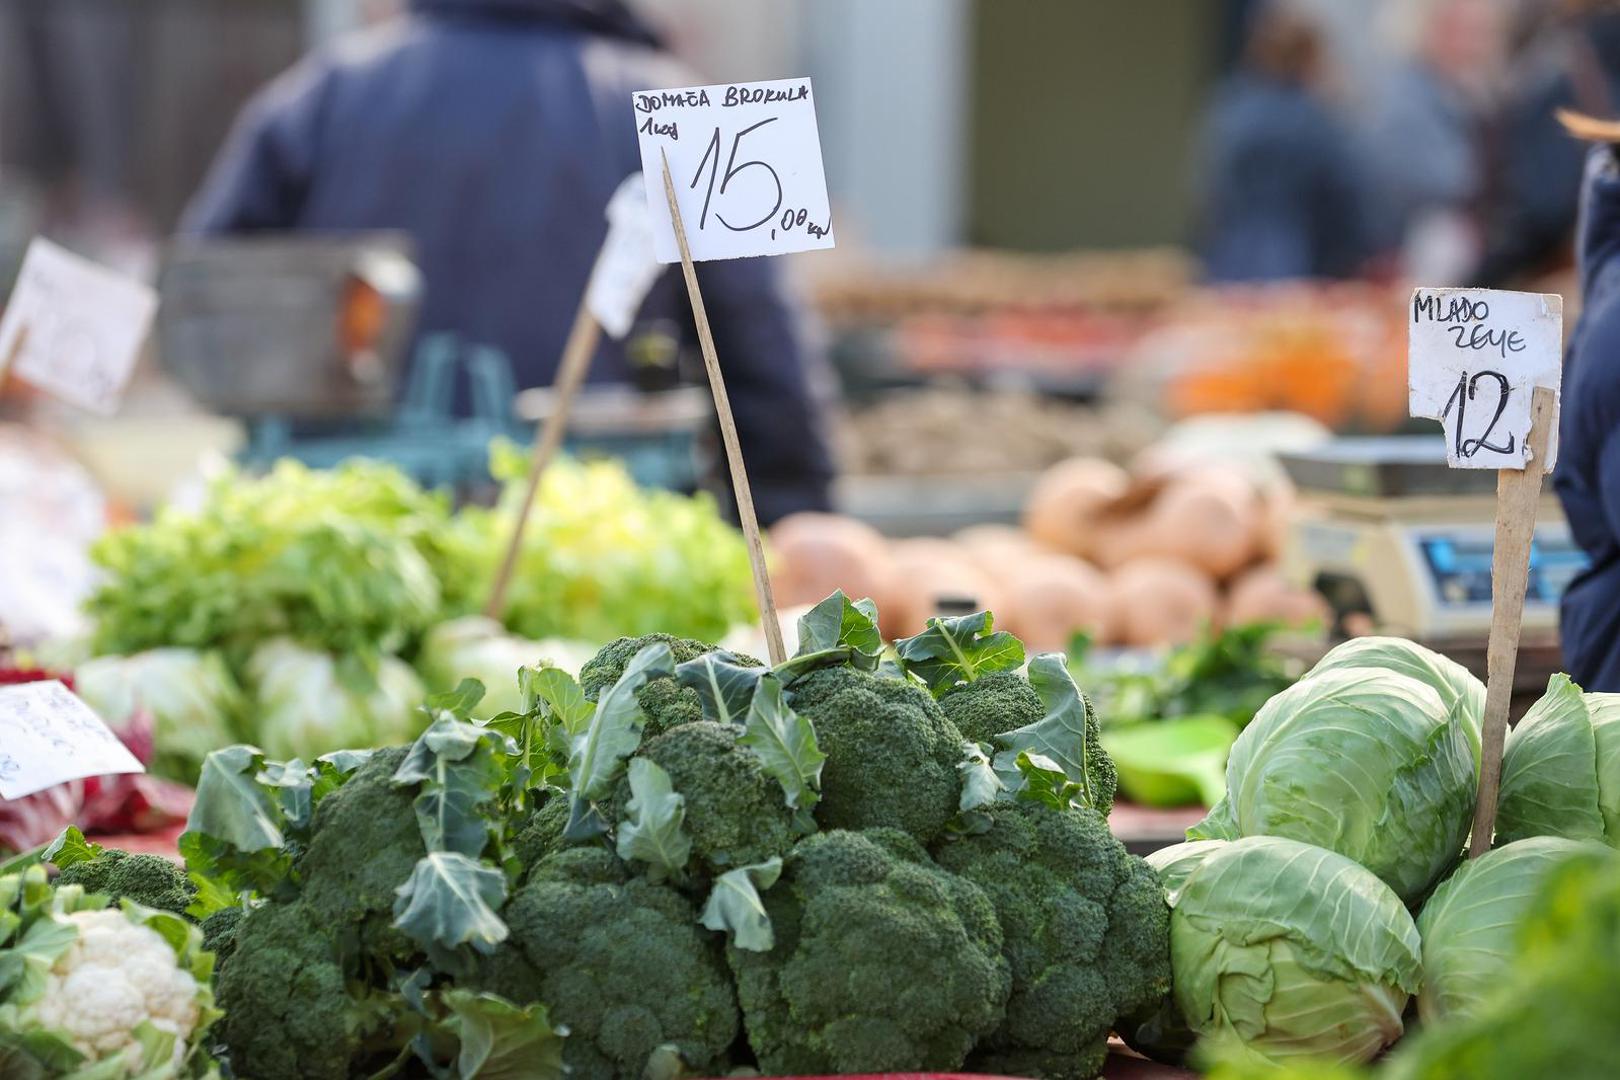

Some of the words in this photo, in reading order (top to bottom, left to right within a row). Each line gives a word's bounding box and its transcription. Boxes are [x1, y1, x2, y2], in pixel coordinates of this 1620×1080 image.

[721, 85, 808, 107] BROKULA
[1414, 293, 1489, 323] MLADO
[1442, 371, 1515, 459] 12
